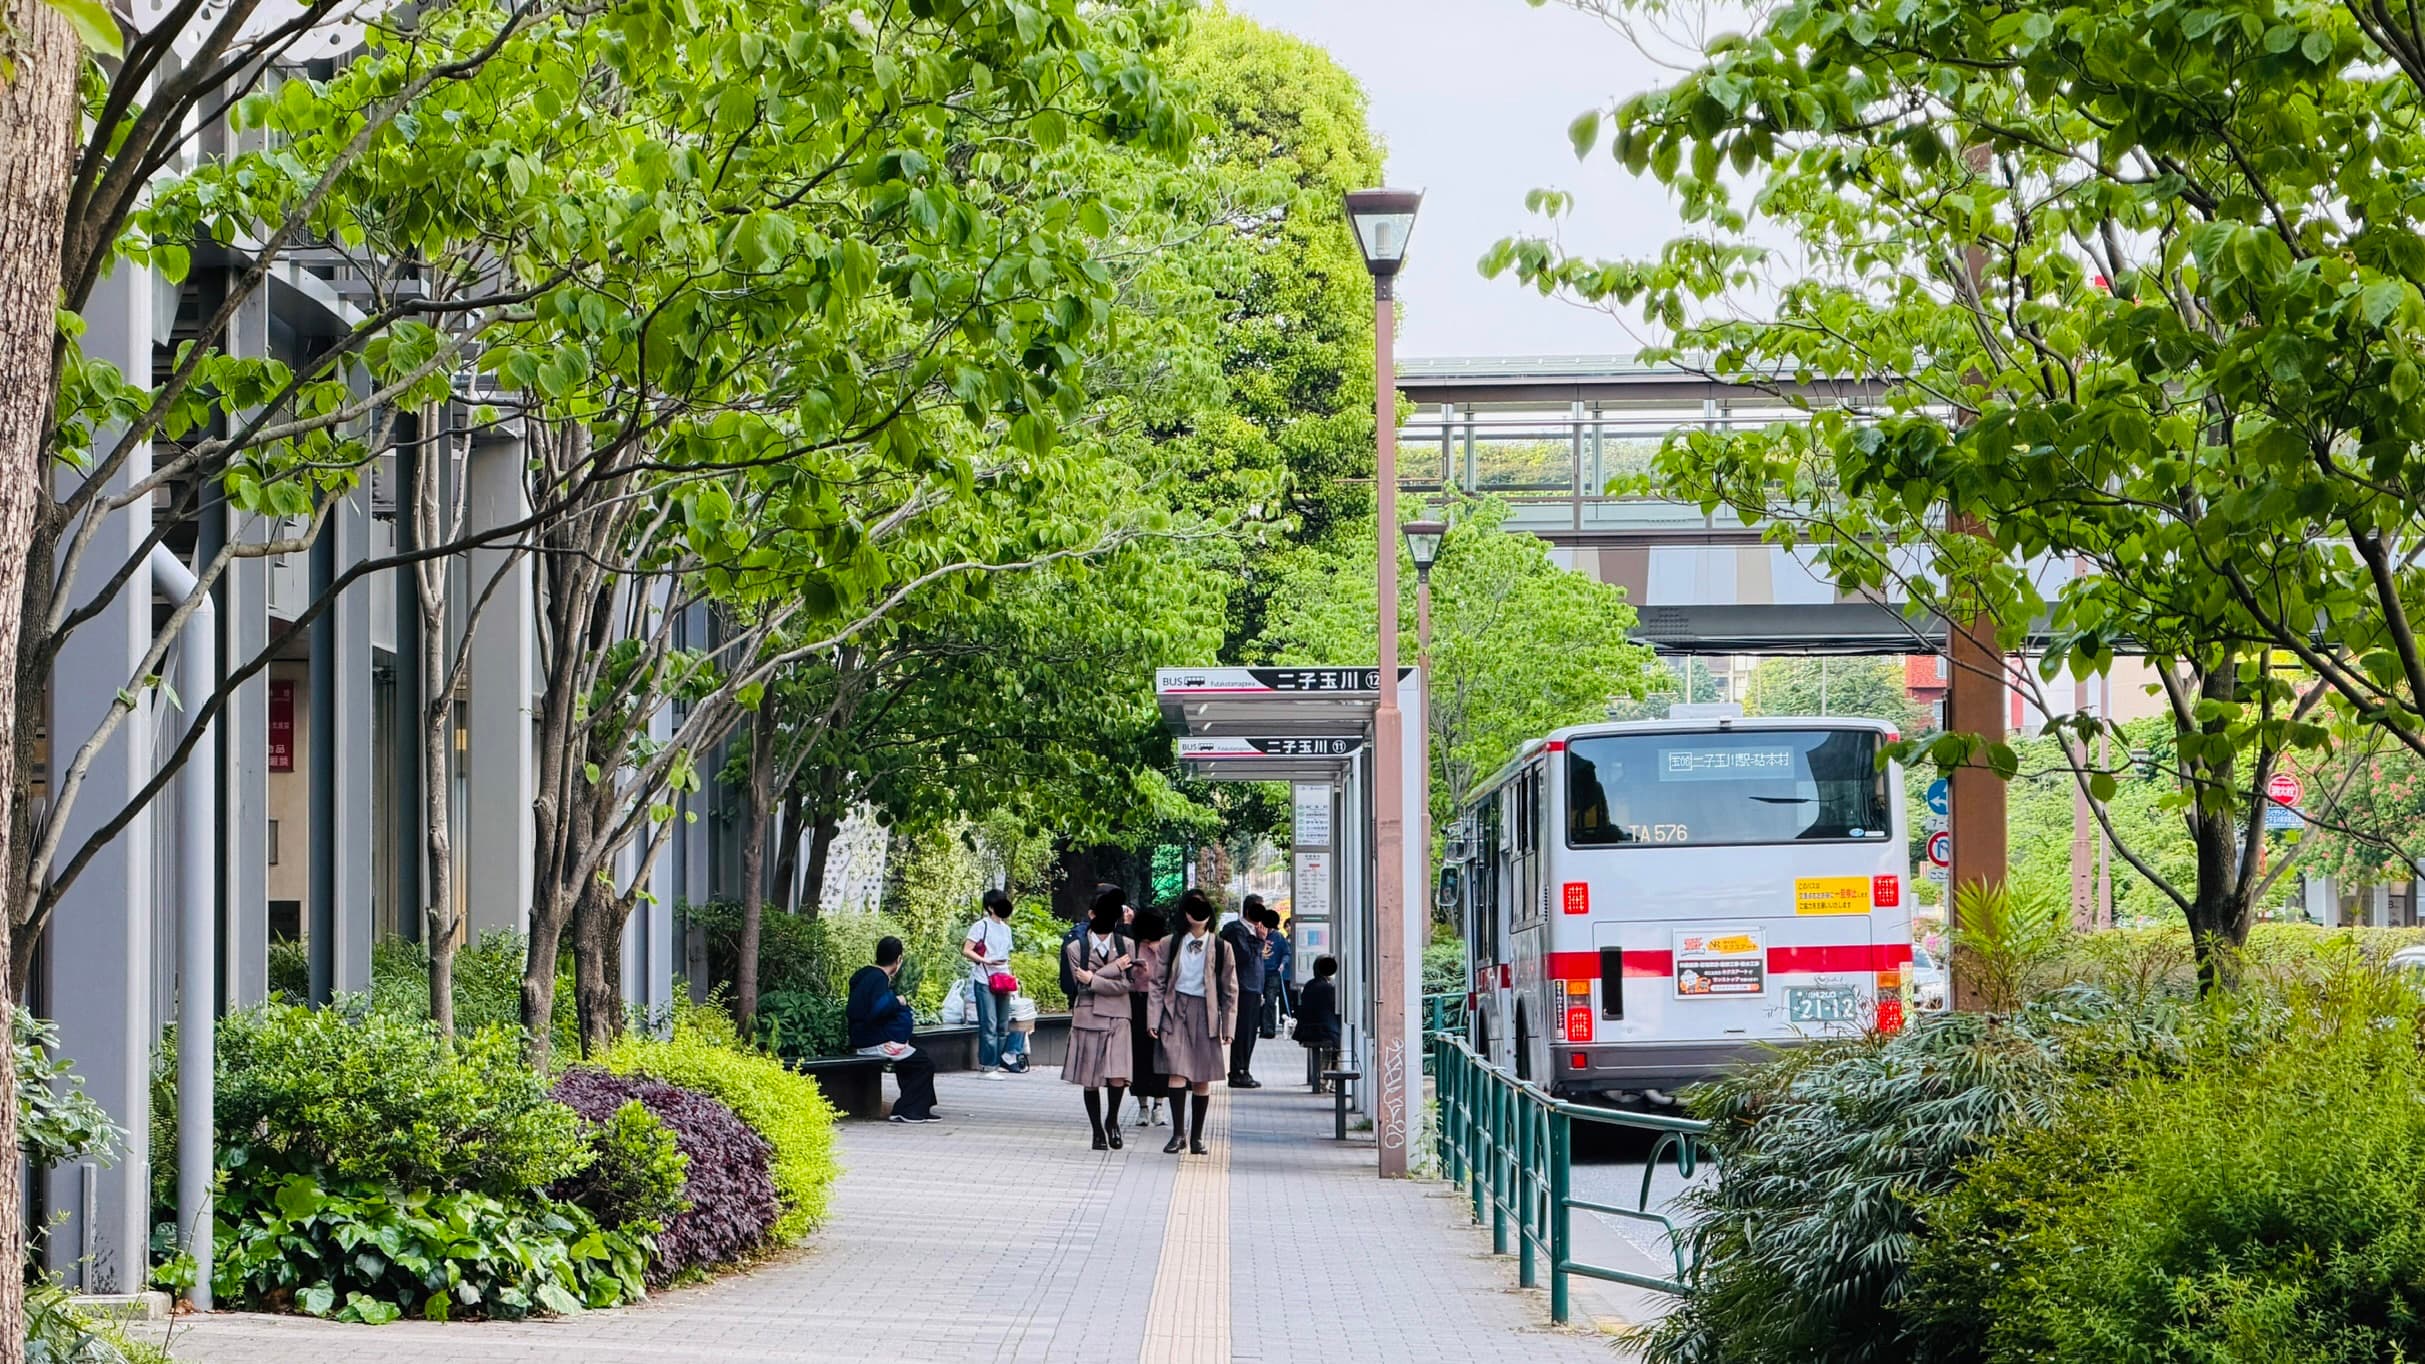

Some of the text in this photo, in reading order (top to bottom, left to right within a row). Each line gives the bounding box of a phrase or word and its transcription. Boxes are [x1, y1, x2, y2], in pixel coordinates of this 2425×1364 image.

[1163, 677, 1183, 687] BUS
[1277, 672, 1358, 689] 二子玉川
[1182, 743, 1197, 751] BUS
[1267, 740, 1327, 754] 二子玉川
[1629, 824, 1688, 843] TA 576
[1800, 998, 1854, 1019] 21-12
